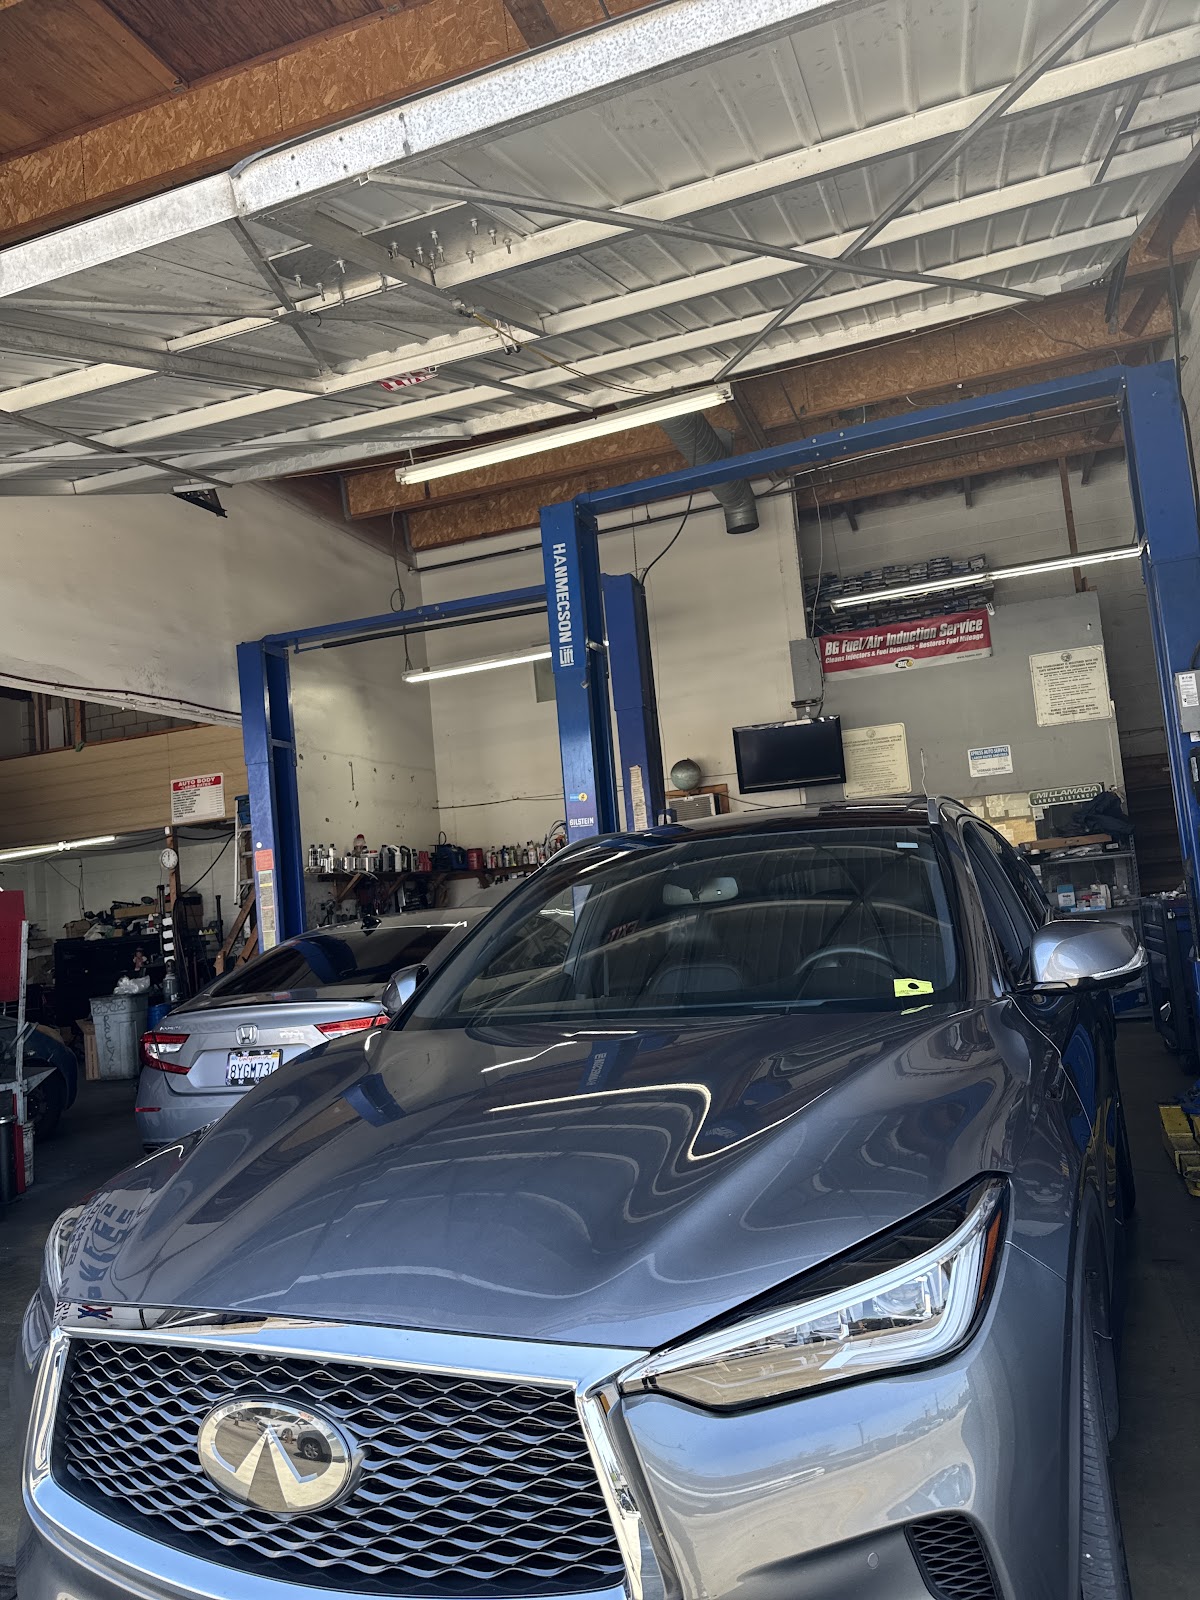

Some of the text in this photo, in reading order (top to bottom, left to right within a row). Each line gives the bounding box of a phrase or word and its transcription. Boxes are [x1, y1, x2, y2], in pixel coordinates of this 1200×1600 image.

[552, 542, 573, 644] HANMECSON
[825, 618, 983, 656] BG Fuel/Air Induction Service
[825, 655, 845, 664] Cleans
[845, 651, 871, 661] Injectors
[876, 648, 889, 656] Fuel
[889, 644, 915, 654] Deposits
[919, 639, 945, 649] Restores
[946, 637, 959, 646] Fuel
[960, 632, 984, 644] Mileage
[1049, 785, 1098, 797] LLAMADA
[1060, 792, 1098, 802] DISTANCIA
[569, 817, 594, 826] BILSTEIN
